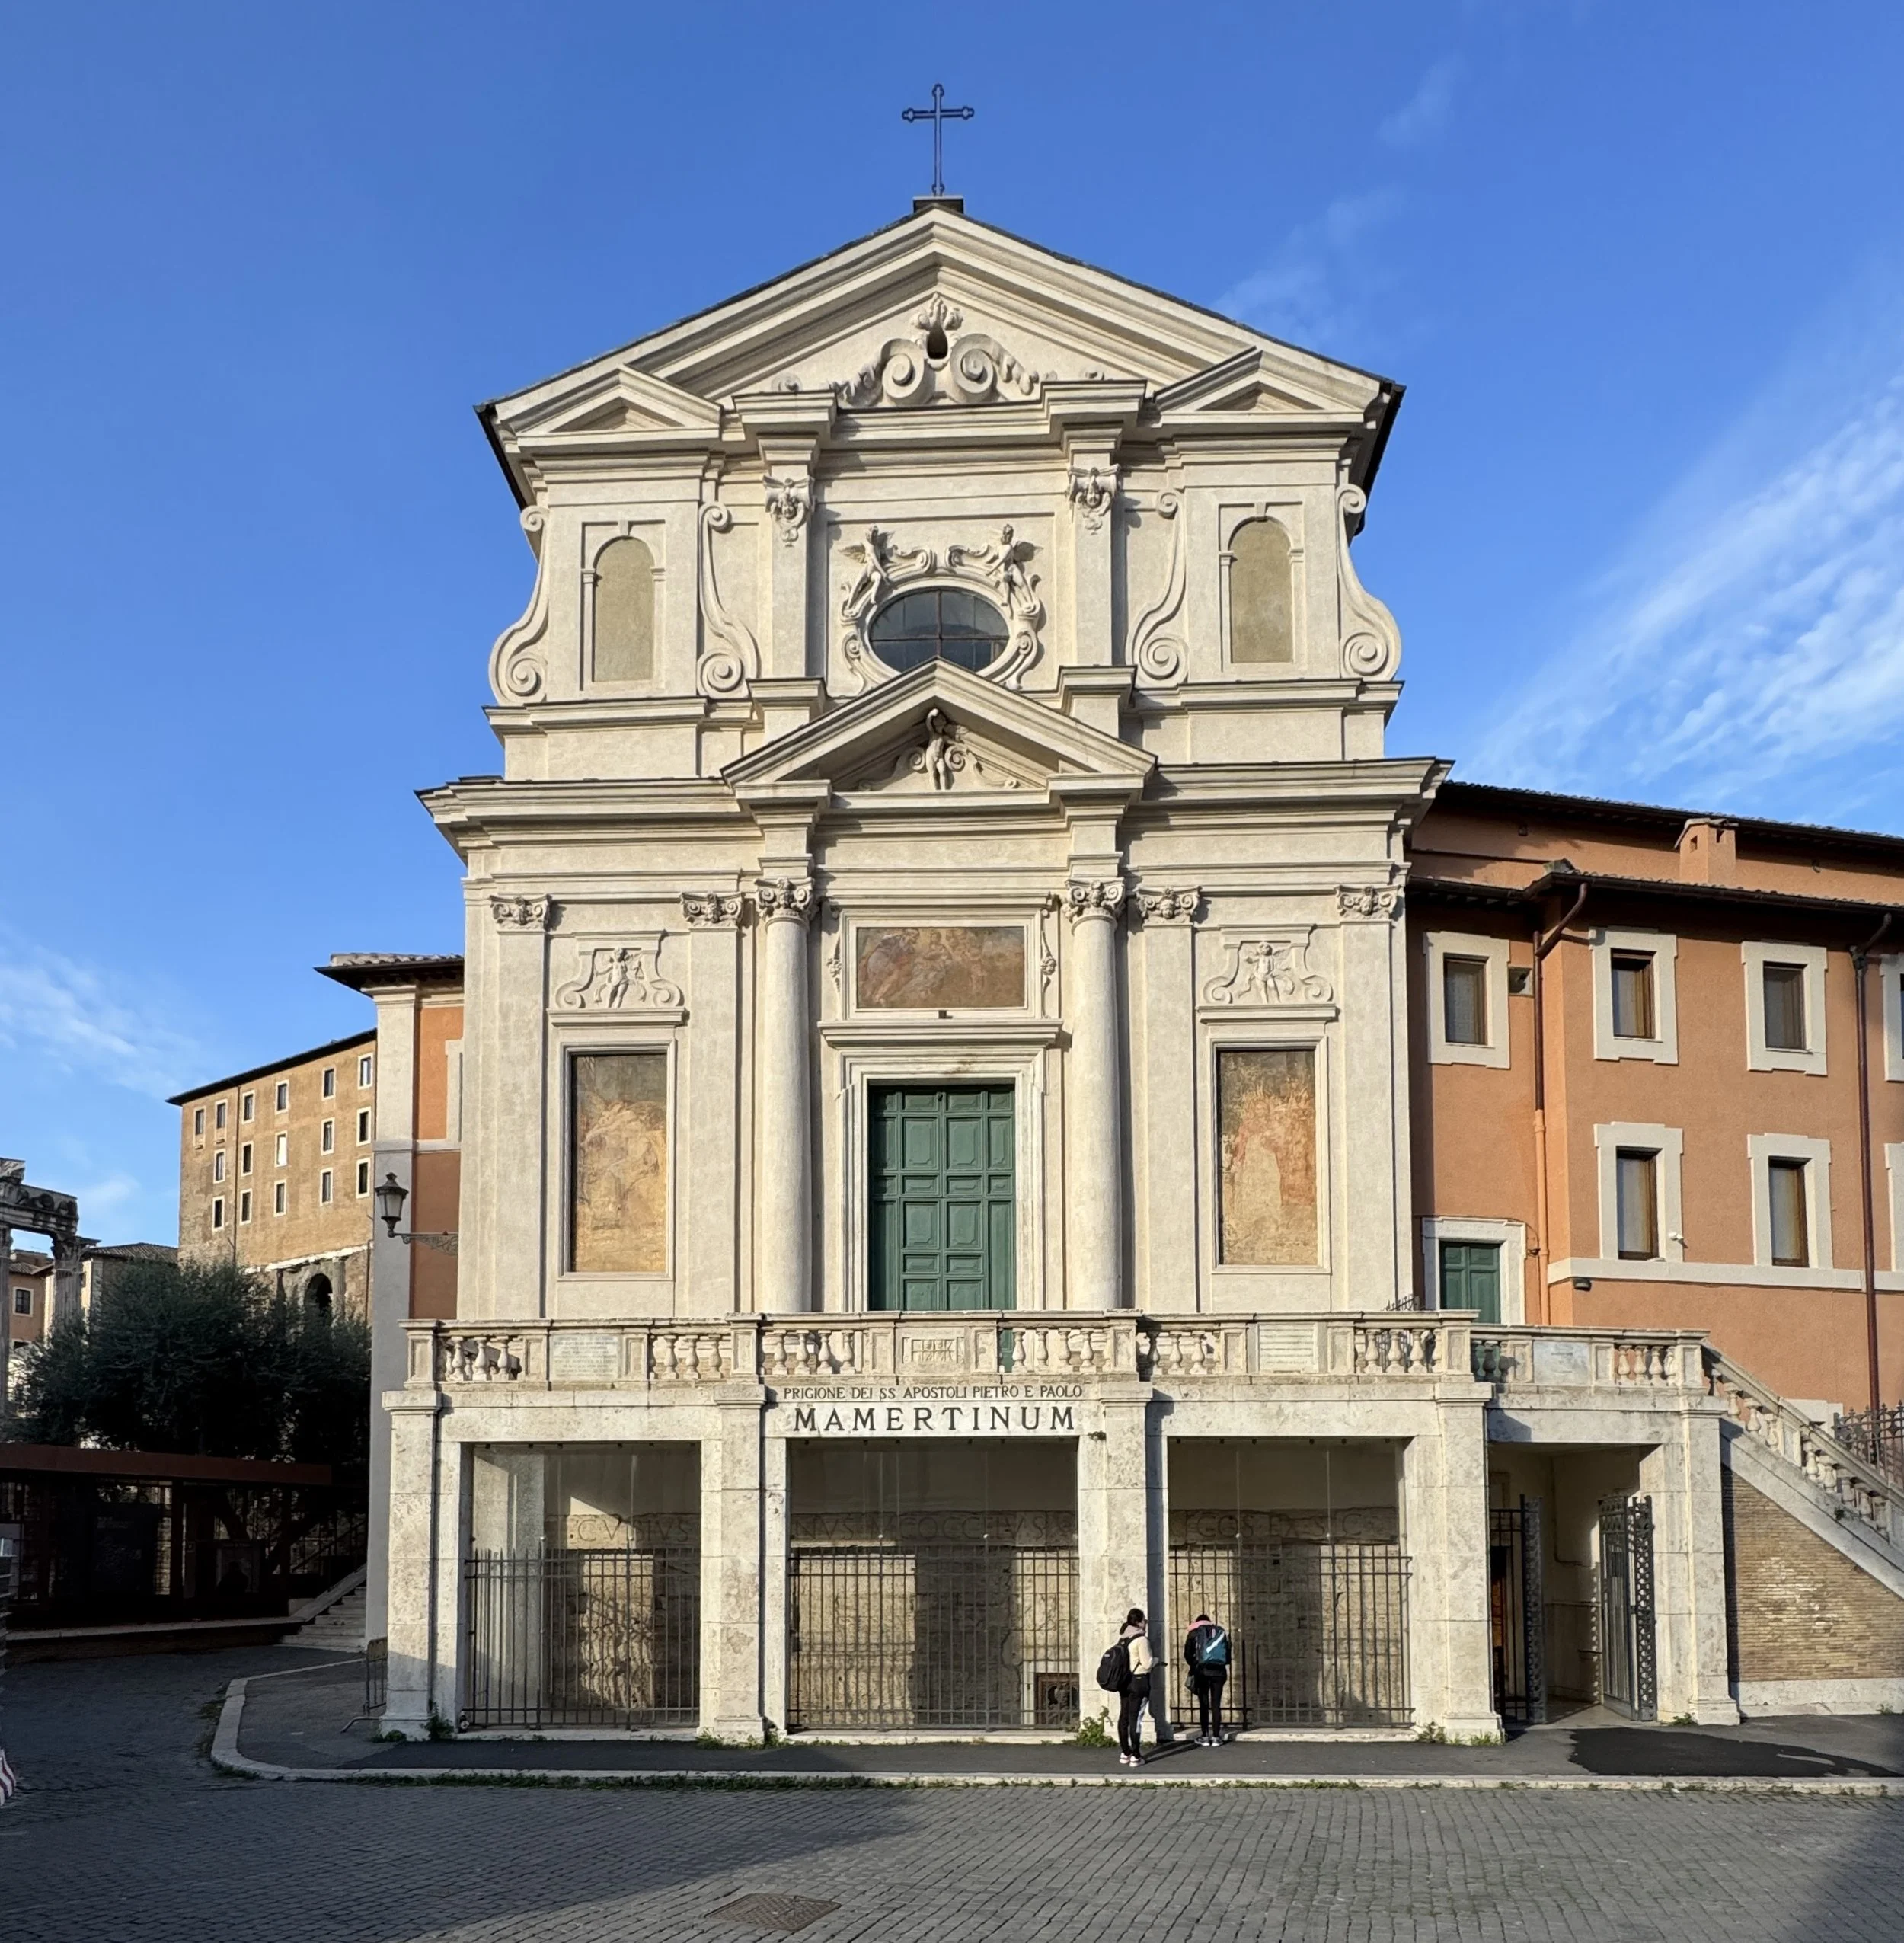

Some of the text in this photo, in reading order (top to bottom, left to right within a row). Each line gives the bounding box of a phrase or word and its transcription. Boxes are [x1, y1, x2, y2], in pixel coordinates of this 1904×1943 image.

[784, 1385, 1082, 1400] PRIGIONE DEI SS APOSTOLI PIETRO E PAOLO
[793, 1406, 1074, 1431] MAMERTINUM
